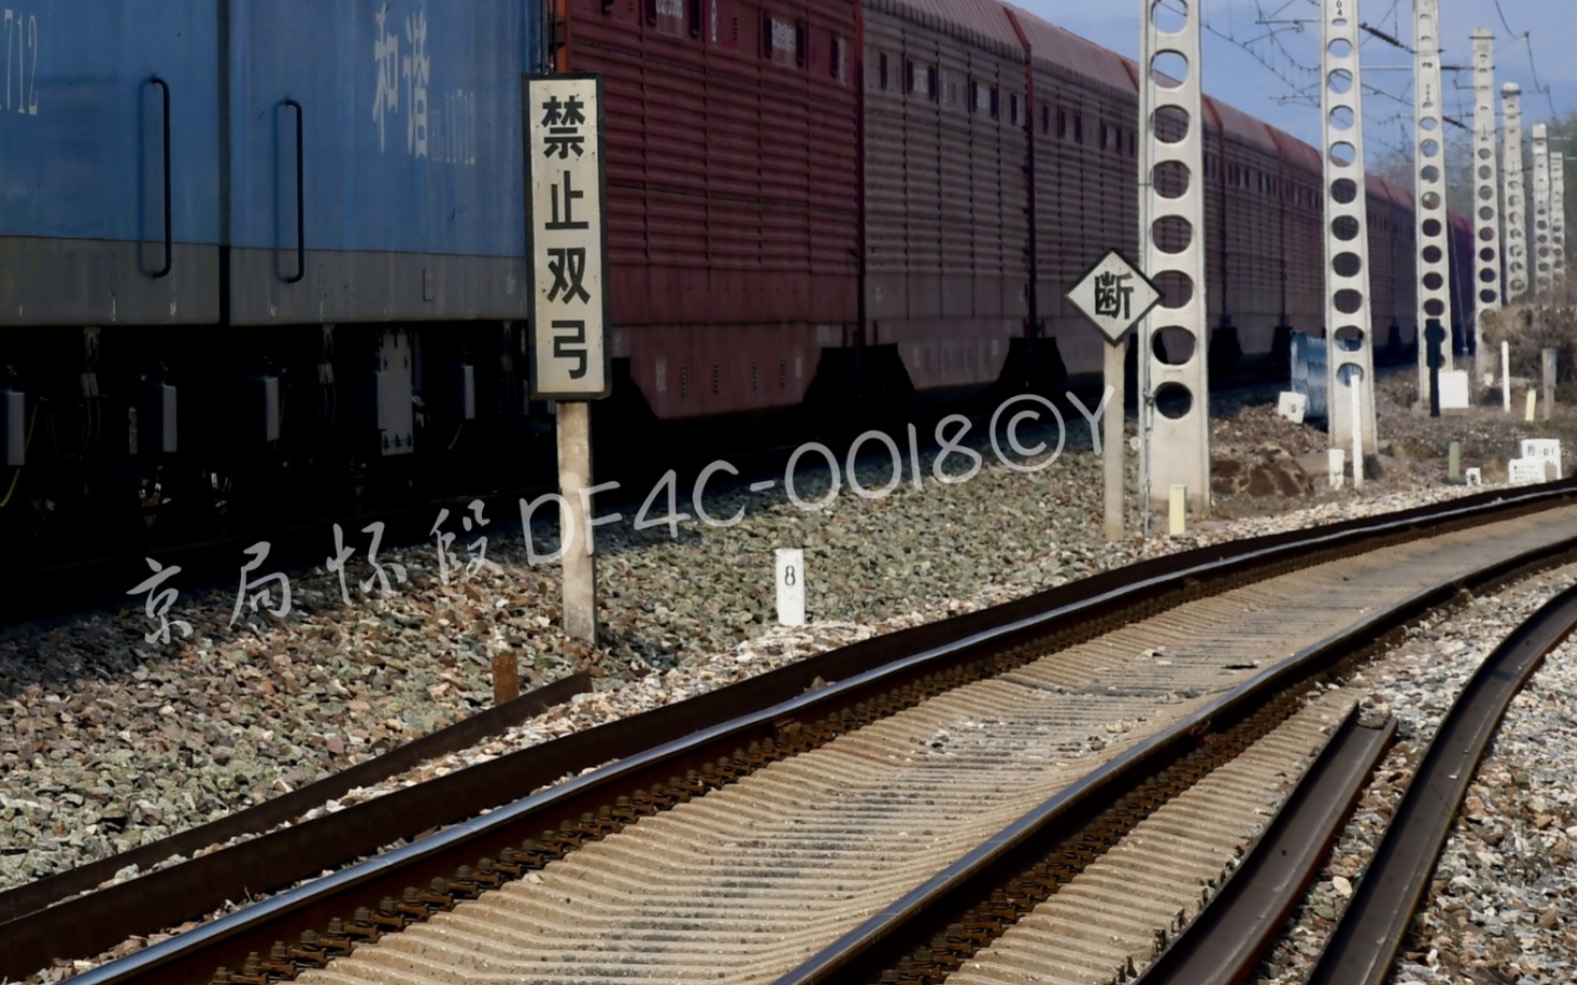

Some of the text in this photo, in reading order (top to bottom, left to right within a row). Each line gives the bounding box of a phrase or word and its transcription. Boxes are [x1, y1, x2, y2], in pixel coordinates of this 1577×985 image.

[372, 2, 431, 159] 和谐
[540, 95, 592, 381] 禁止双弓
[1094, 271, 1135, 320] 断
[784, 565, 796, 586] 8
